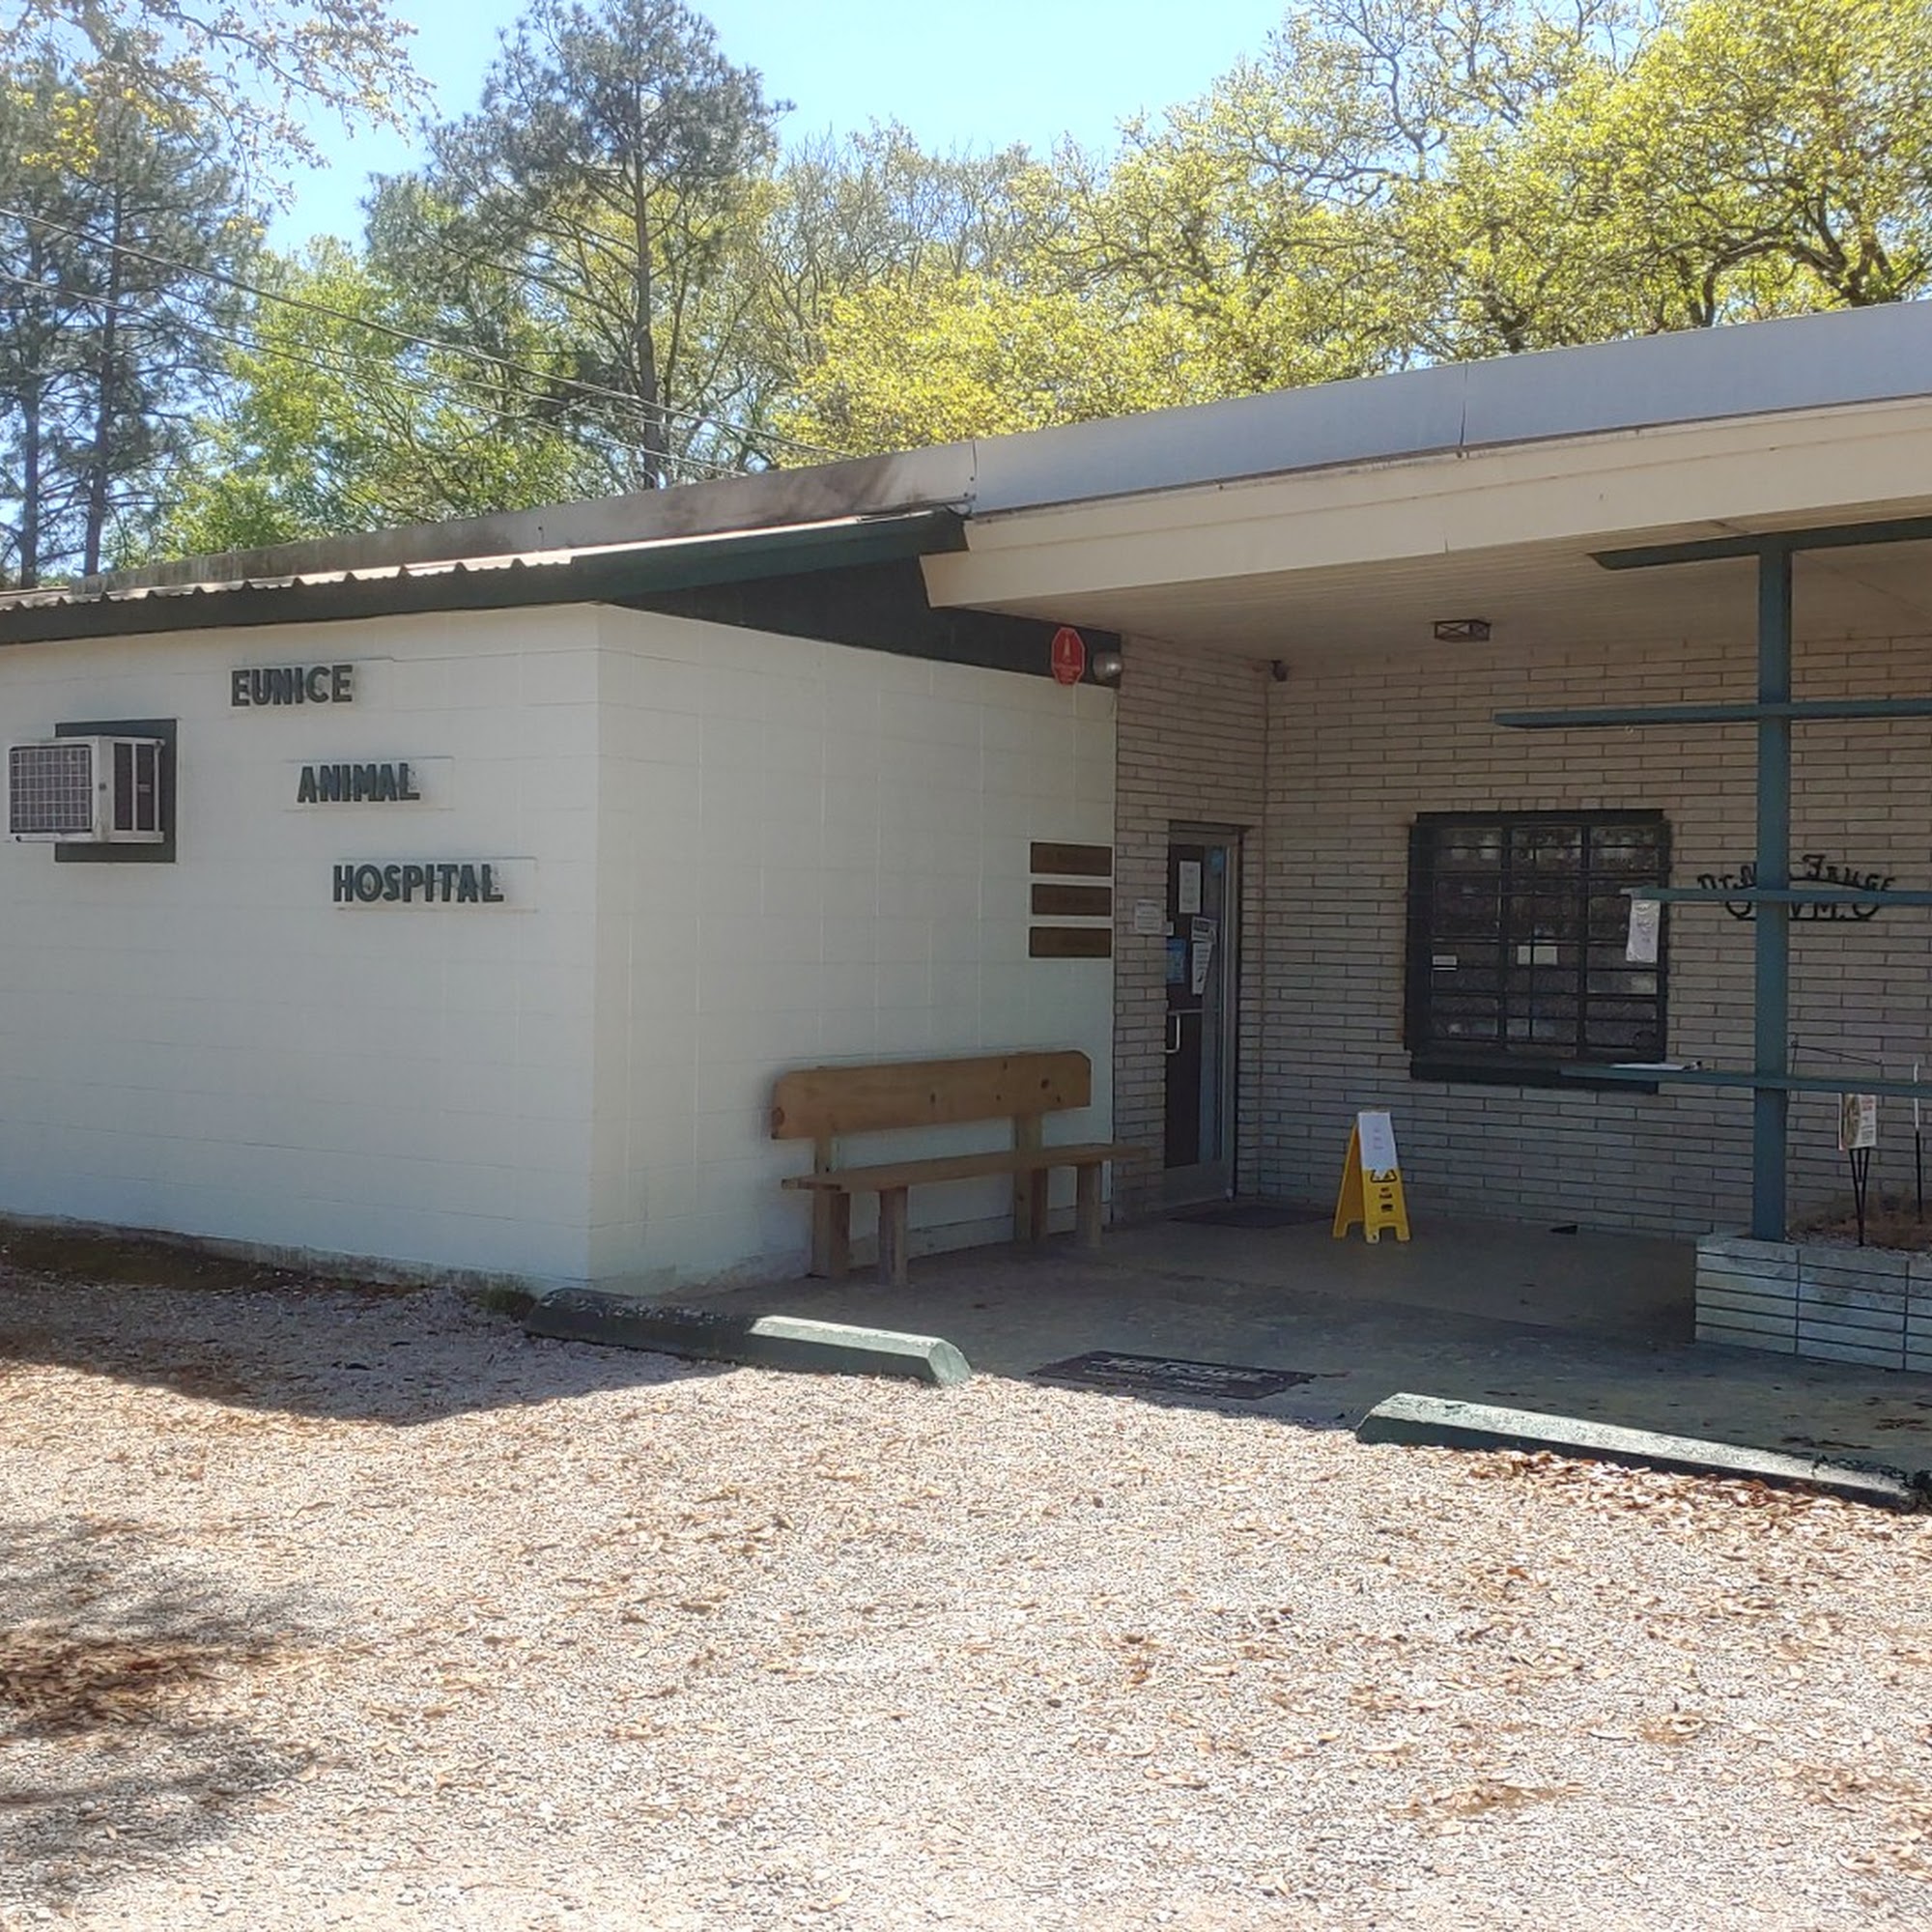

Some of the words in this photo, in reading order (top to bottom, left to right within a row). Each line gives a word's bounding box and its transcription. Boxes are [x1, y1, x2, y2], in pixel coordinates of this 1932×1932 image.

[231, 664, 354, 707] EUNICE
[297, 761, 420, 804] ANIMAL
[332, 863, 504, 903] HOSPITAL
